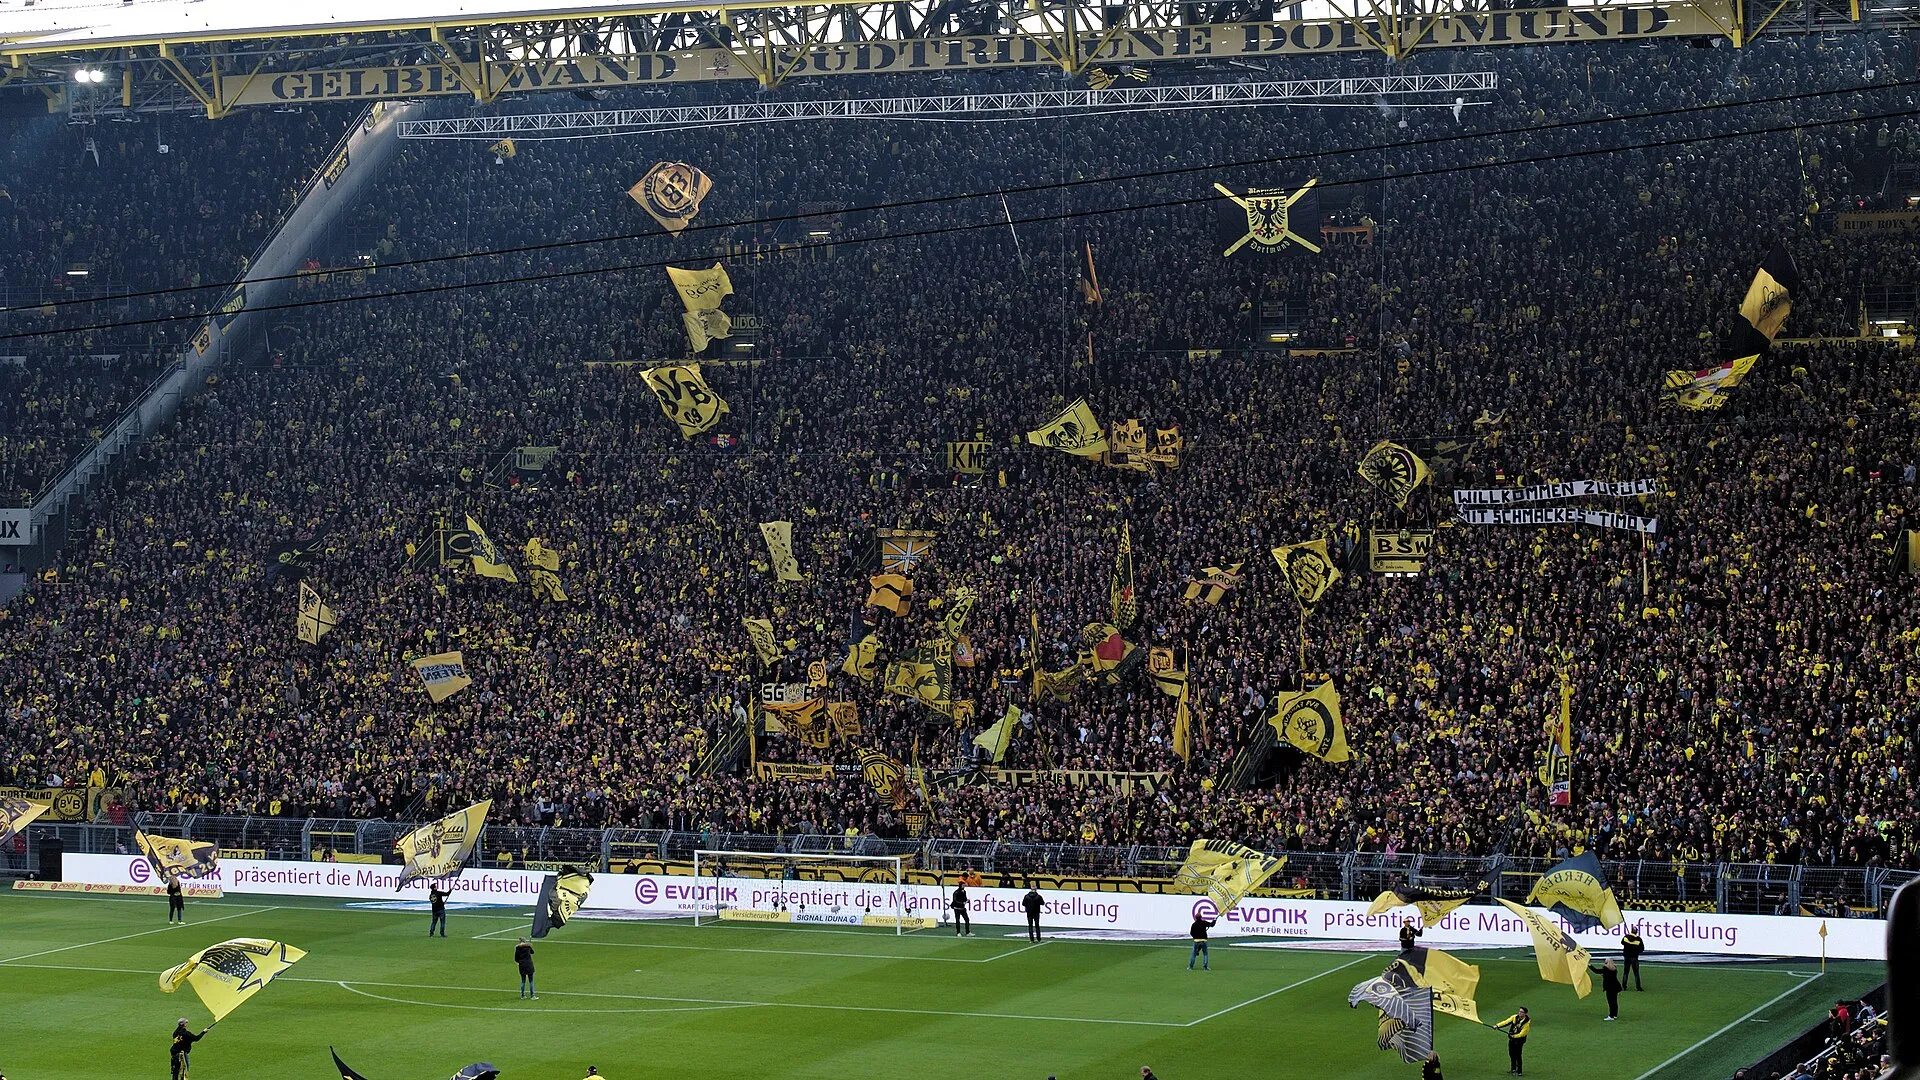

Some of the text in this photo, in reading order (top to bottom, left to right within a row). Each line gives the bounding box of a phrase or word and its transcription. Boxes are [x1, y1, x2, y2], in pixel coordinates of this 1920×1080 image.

[271, 7, 1670, 100] GELBE WAND SÜDTRIBÜNE DORTMUND
[1250, 240, 1291, 254] Dortmund
[653, 369, 712, 416] BVB
[684, 407, 702, 425] 09
[1458, 479, 1656, 503] WILLKOMMEN ZURÜCK
[1462, 509, 1488, 523] MIT
[1377, 535, 1432, 554] BSW
[763, 685, 785, 702] SG
[0, 789, 52, 800] DORTMUND
[59, 795, 81, 810] BVB
[189, 881, 201, 889] FÜR
[234, 866, 322, 887] präsentiert
[326, 867, 351, 886] die
[665, 885, 738, 902] EVONIK
[752, 886, 849, 908] präsentiert
[855, 889, 882, 909] die
[796, 913, 848, 923] SIGNAL IDUNA
[1226, 906, 1308, 925] EVONIK
[1324, 909, 1425, 931] präsentier
[1440, 915, 1471, 931] die
[1240, 926, 1265, 934] KRAFT
[1267, 926, 1282, 935] FÜR
